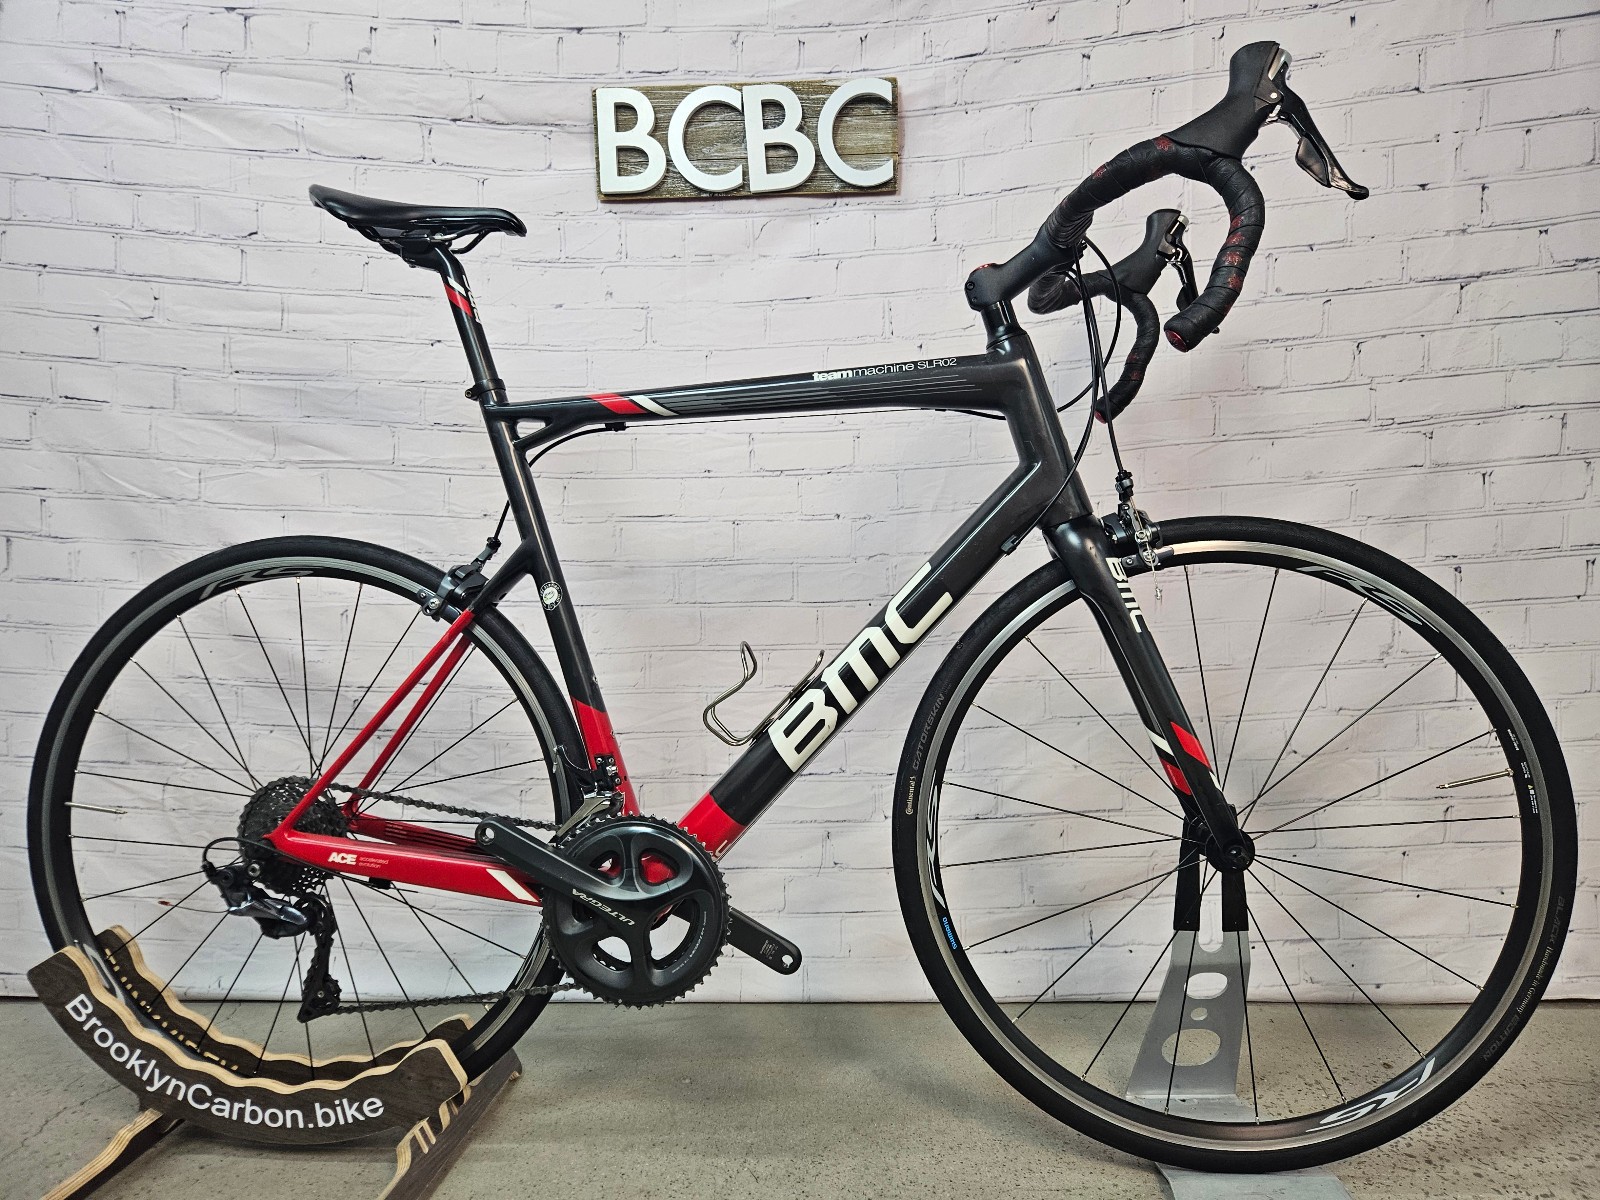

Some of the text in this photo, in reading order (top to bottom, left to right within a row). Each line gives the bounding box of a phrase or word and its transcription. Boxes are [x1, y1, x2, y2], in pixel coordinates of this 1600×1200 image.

[595, 77, 895, 195] BCBC
[917, 357, 957, 370] SLR02
[913, 693, 945, 771] GATORSKIN
[328, 851, 358, 866] ACE
[572, 888, 635, 926] ULTEGRA
[1550, 895, 1565, 944] BLACK
[1535, 946, 1554, 982] Handmade
[1516, 986, 1537, 1015] Germany
[1482, 1014, 1521, 1062] EDITION
[65, 993, 385, 1129] BrooklynCarbon.bike
